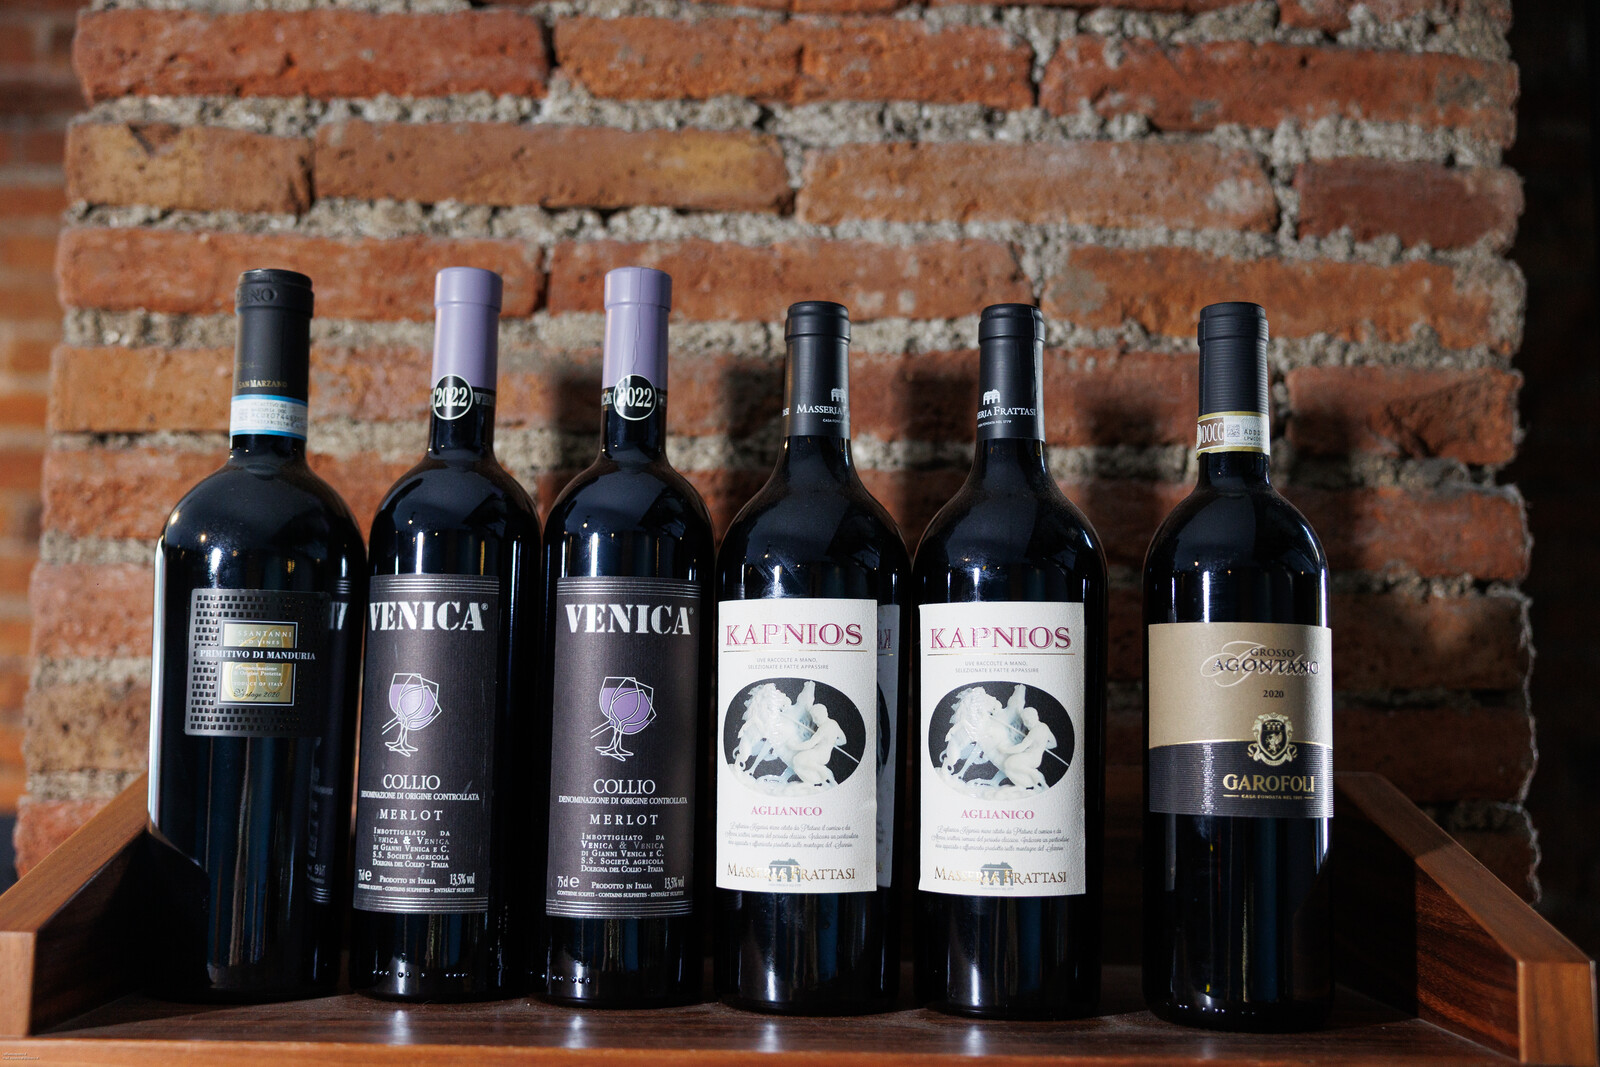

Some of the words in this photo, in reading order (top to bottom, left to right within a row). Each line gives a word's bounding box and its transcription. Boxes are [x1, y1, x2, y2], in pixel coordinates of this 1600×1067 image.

[436, 386, 468, 408] 2022
[616, 386, 652, 408] 2022
[796, 404, 842, 415] MASSERIA
[994, 406, 1036, 416] FRATTASI
[370, 601, 484, 631] VENICA
[564, 604, 692, 635] VENICA
[237, 630, 292, 638] SSANTANNI
[726, 623, 863, 646] KAPNIOS
[930, 626, 1071, 649] KAPNIOS
[200, 649, 250, 659] PRIMITIVO
[252, 650, 264, 659] DI
[266, 651, 316, 660] MANDURIA
[1250, 648, 1295, 658] GROSSO
[1212, 658, 1320, 674] AGONTANO
[1264, 690, 1284, 698] 2020
[382, 774, 440, 790] COLLIO
[593, 778, 656, 794] COLLIO
[1222, 774, 1314, 792] GAROFOLI
[405, 792, 432, 800] ORIGINE
[433, 793, 480, 801] CONTROLLATA
[558, 796, 610, 804] DENOMINAZIONE
[380, 808, 442, 820] MERLOT
[751, 806, 822, 816] AGLIANICO
[960, 810, 1035, 820] AGLIANICO
[590, 814, 658, 826] MERLOT
[373, 834, 398, 844] VENICA
[402, 836, 411, 844] &
[416, 836, 450, 845] VENICA
[582, 832, 642, 840] IMBOTTIGLIATO
[380, 844, 402, 852] GIANNI
[581, 840, 614, 849] VENICA
[619, 841, 627, 850] &
[600, 857, 630, 865] SOCIETÀ
[727, 862, 786, 880] MASSERIA
[791, 866, 856, 882] FRATTASI
[934, 866, 998, 884] MASSERIA
[1004, 869, 1067, 884] FRATTASI
[380, 875, 408, 884] PRODOTTO
[418, 876, 436, 884] ITALIA
[570, 876, 580, 888] e
[592, 882, 624, 890] PRODOTTO
